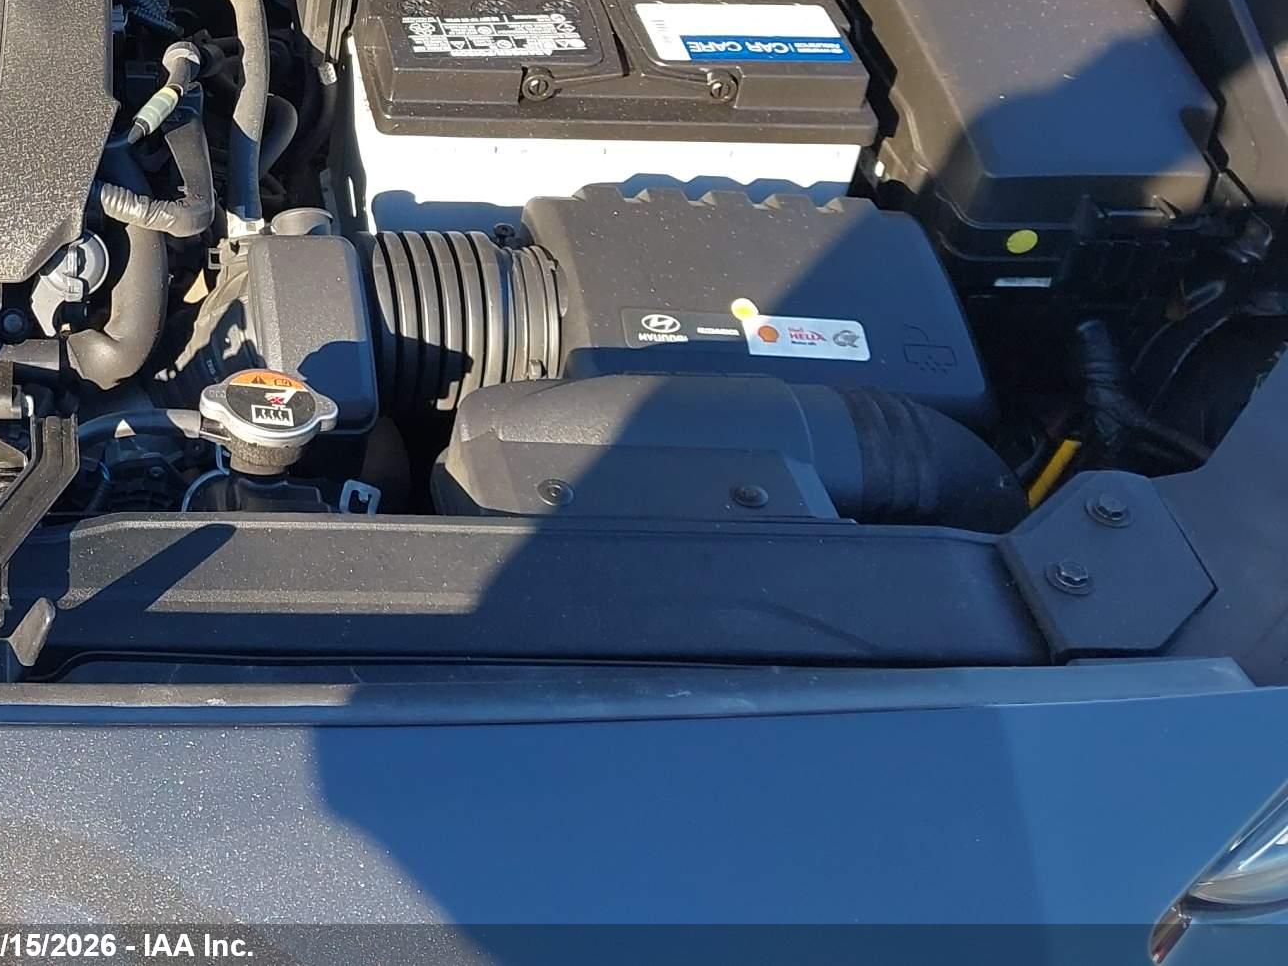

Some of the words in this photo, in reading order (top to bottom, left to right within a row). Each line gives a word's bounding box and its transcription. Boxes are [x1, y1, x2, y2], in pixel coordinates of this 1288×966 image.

[687, 40, 740, 53] CARE
[743, 41, 791, 54] CAR
[638, 333, 688, 343] HYUNDAI
